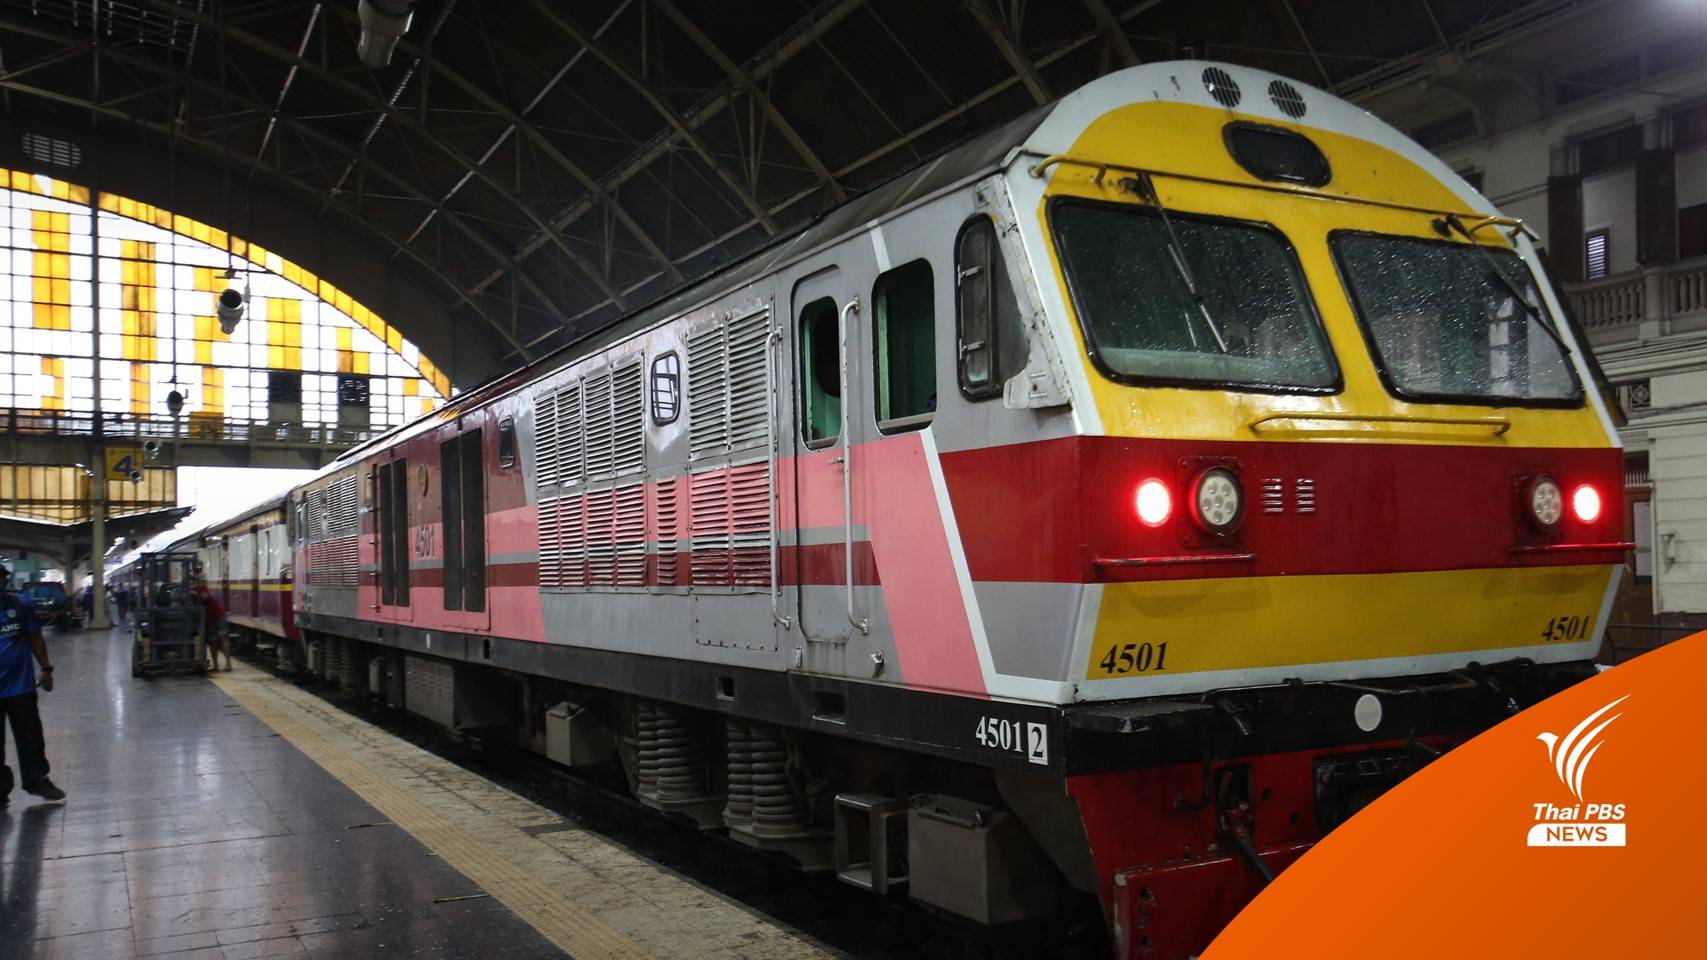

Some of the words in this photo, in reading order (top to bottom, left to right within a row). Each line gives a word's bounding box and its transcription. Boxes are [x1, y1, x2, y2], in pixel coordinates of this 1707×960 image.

[111, 453, 133, 477] 4
[415, 525, 435, 558] 4501
[1541, 615, 1590, 642] 4501
[1100, 641, 1168, 674] 4501
[975, 716, 1024, 753] 4501
[1031, 725, 1045, 759] 2
